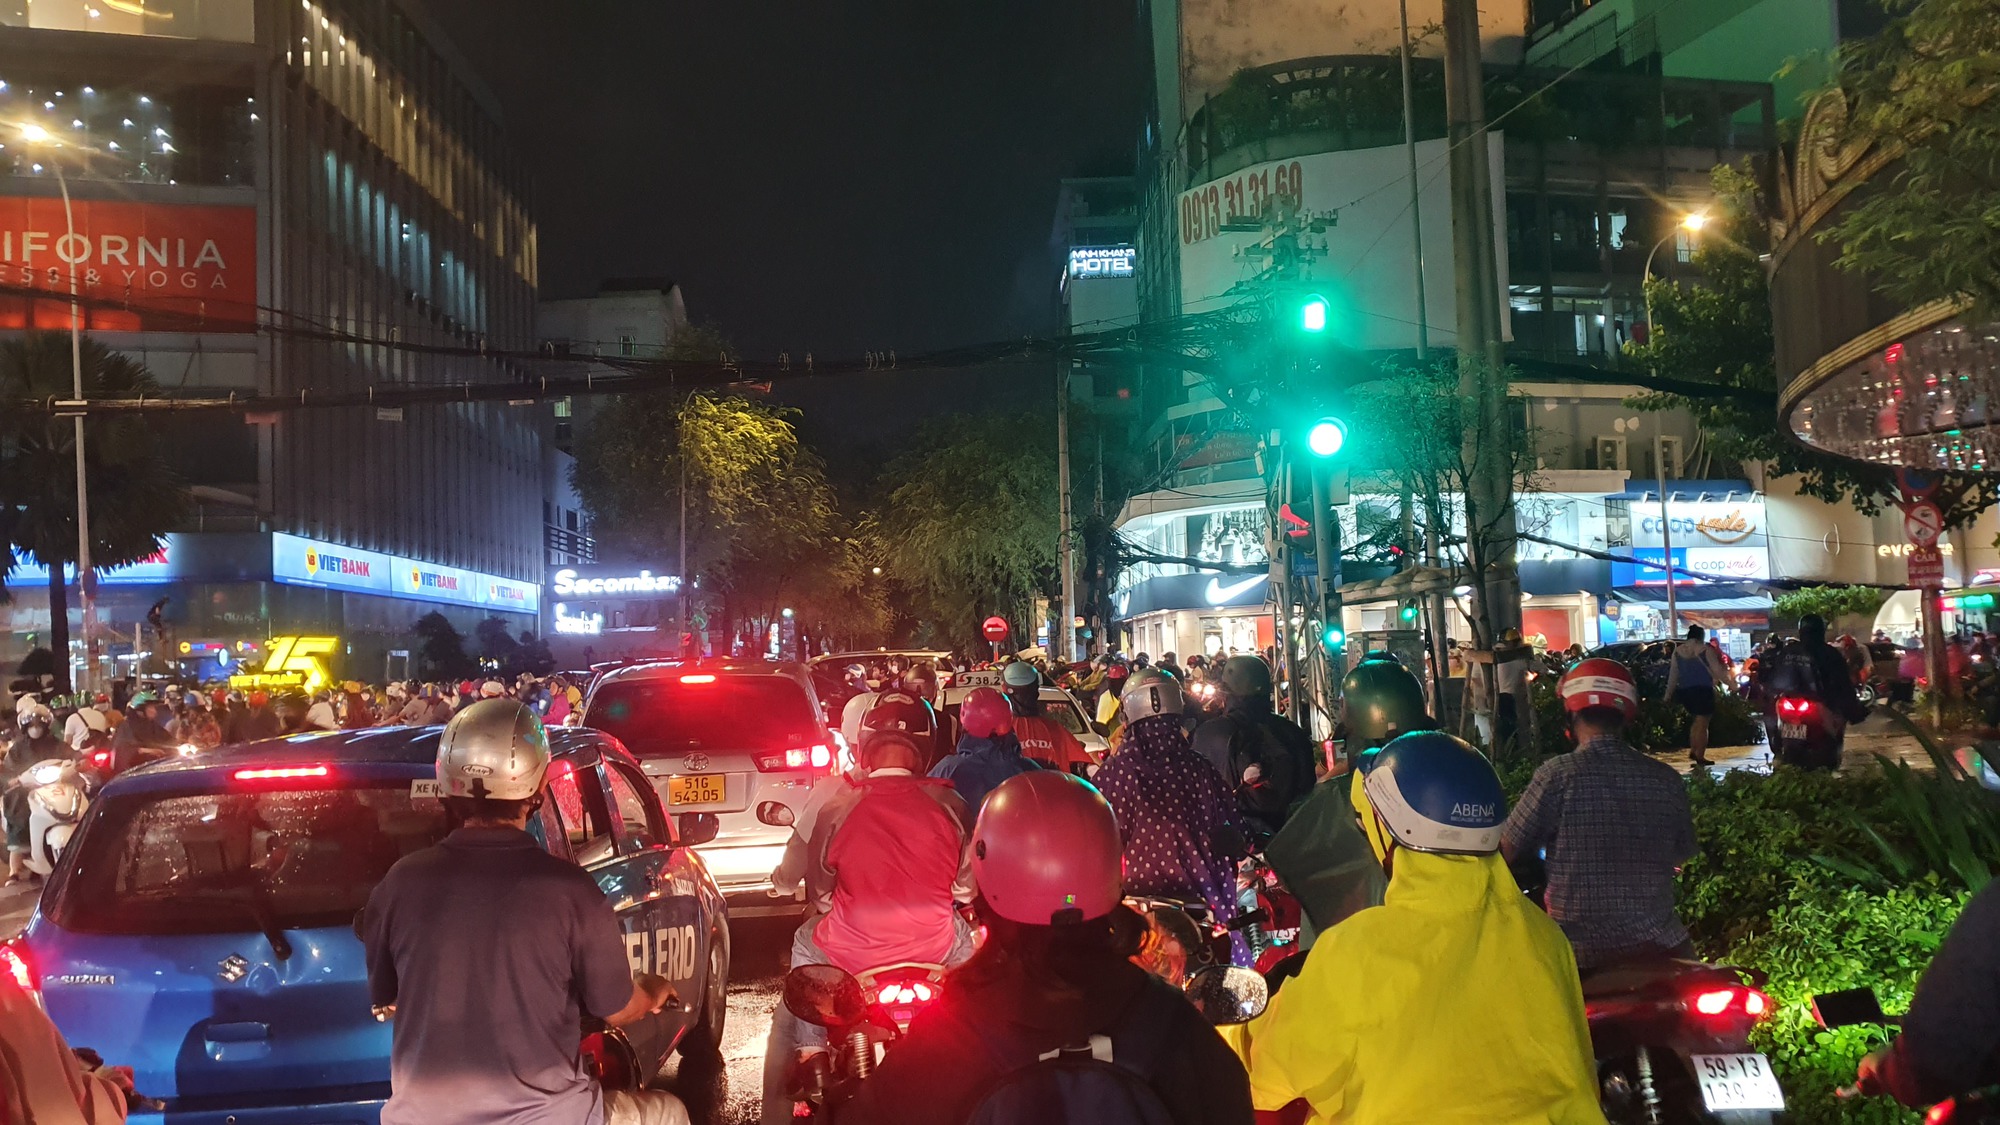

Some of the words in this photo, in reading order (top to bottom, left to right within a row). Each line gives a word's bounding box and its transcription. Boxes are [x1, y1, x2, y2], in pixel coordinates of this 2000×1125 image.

[1182, 185, 1220, 244] 0913
[1224, 176, 1245, 225] 31
[3, 231, 226, 269] IFORNIA
[1072, 257, 1134, 272] HOTEL
[122, 269, 227, 289] YOGA
[318, 553, 371, 578] VIETBANK
[420, 571, 458, 590] VIETBANK
[415, 783, 430, 793] XE
[684, 777, 709, 789] 51G
[674, 789, 719, 803] 543.05
[621, 925, 696, 983] ELERIO
[60, 974, 115, 985] SUZUKI
[1702, 1056, 1762, 1079] 59-Y3
